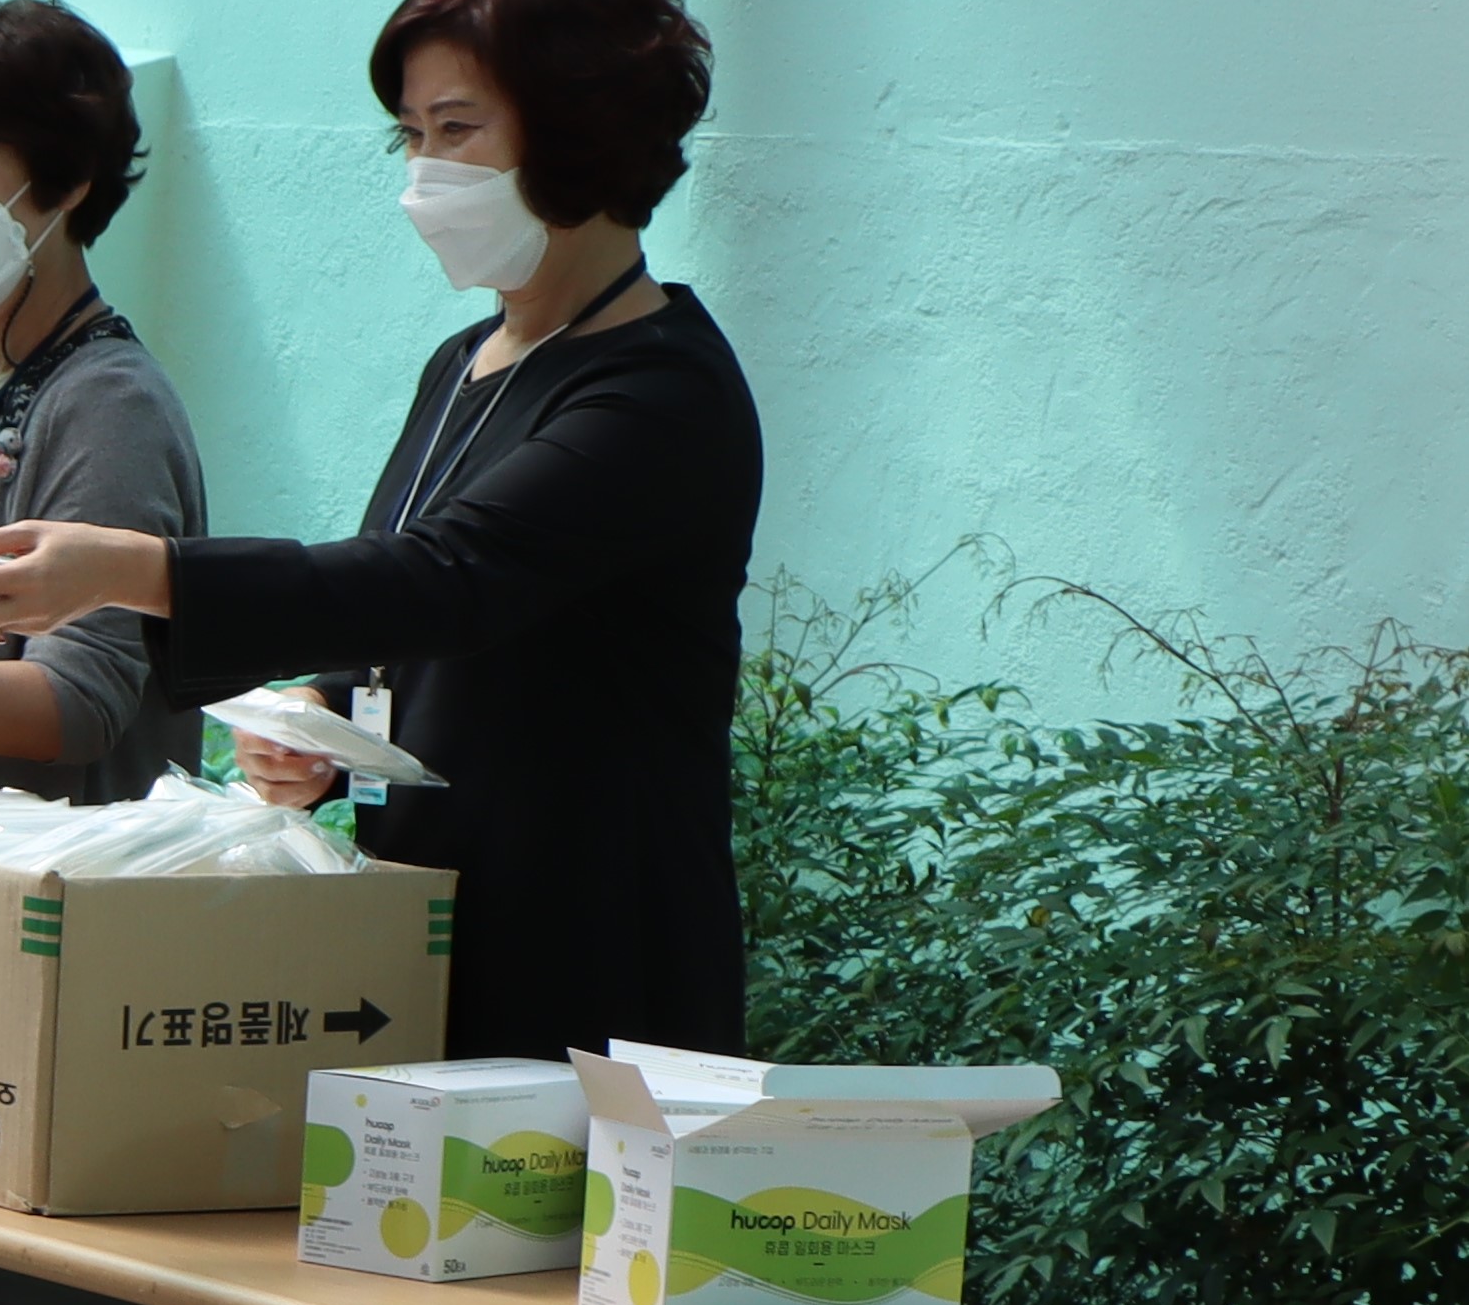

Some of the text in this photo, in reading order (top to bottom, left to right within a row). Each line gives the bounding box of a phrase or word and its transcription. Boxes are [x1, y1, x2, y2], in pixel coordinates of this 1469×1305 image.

[121, 1001, 310, 1050] 제품명표기
[529, 1151, 562, 1174] Daily
[730, 1209, 911, 1236] hucop Daily Mask
[837, 1241, 876, 1256] 마스크
